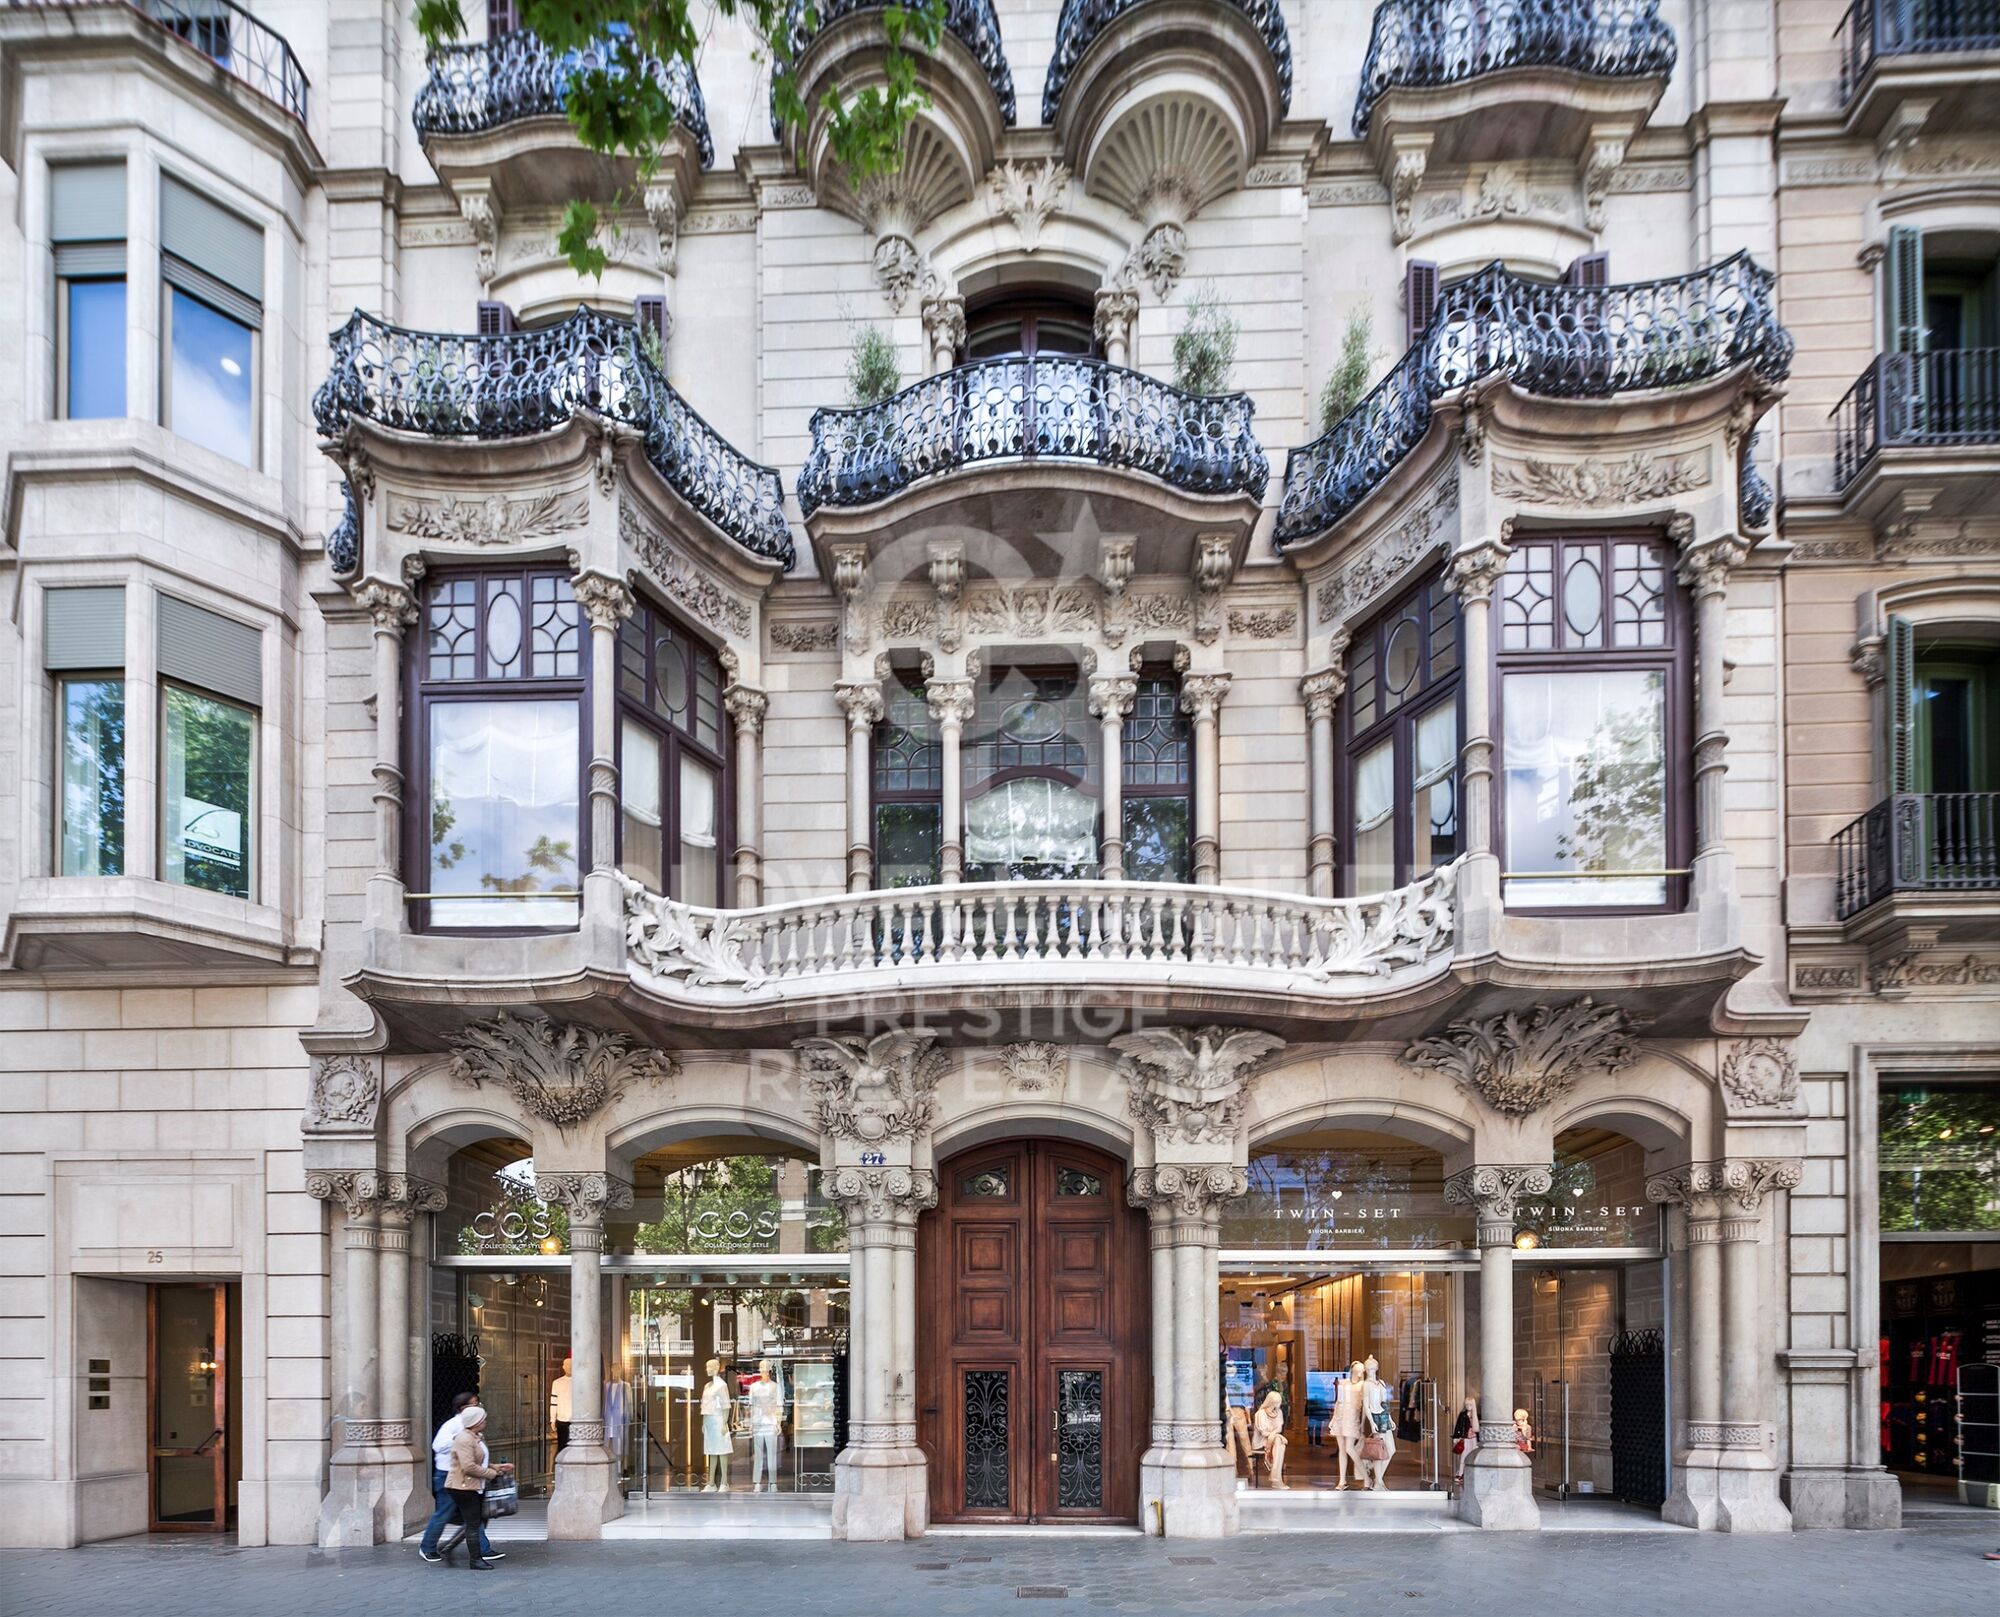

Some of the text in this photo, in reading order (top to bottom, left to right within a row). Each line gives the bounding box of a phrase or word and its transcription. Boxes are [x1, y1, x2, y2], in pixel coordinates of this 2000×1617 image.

[864, 1152, 881, 1164] 27
[472, 1211, 551, 1239] COS
[696, 1211, 776, 1238] COS
[147, 1250, 163, 1263] 25
[798, 1473, 832, 1486] COS
